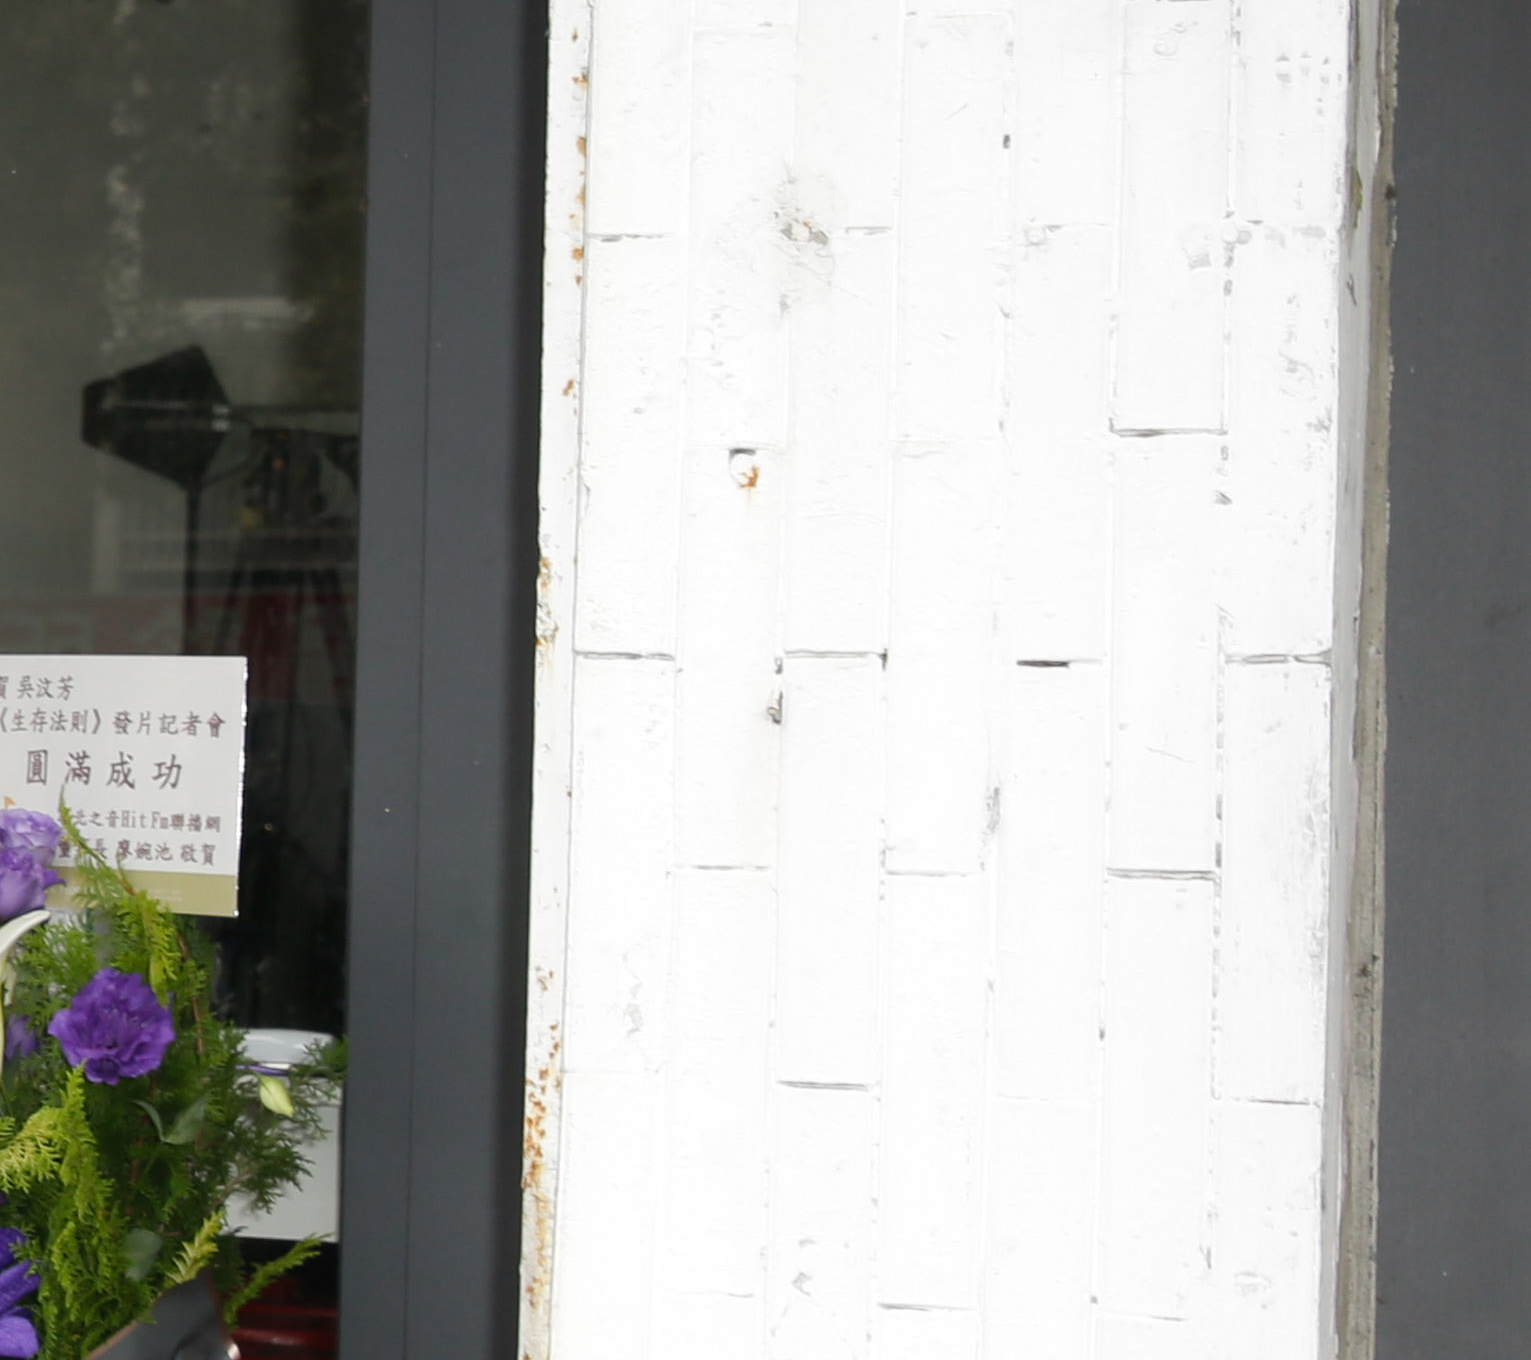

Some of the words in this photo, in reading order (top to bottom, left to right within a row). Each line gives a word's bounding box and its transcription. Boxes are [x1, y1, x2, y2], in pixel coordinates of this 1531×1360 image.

[16, 675, 75, 701] 吳汶芳
[25, 748, 183, 790] 圓滿成功
